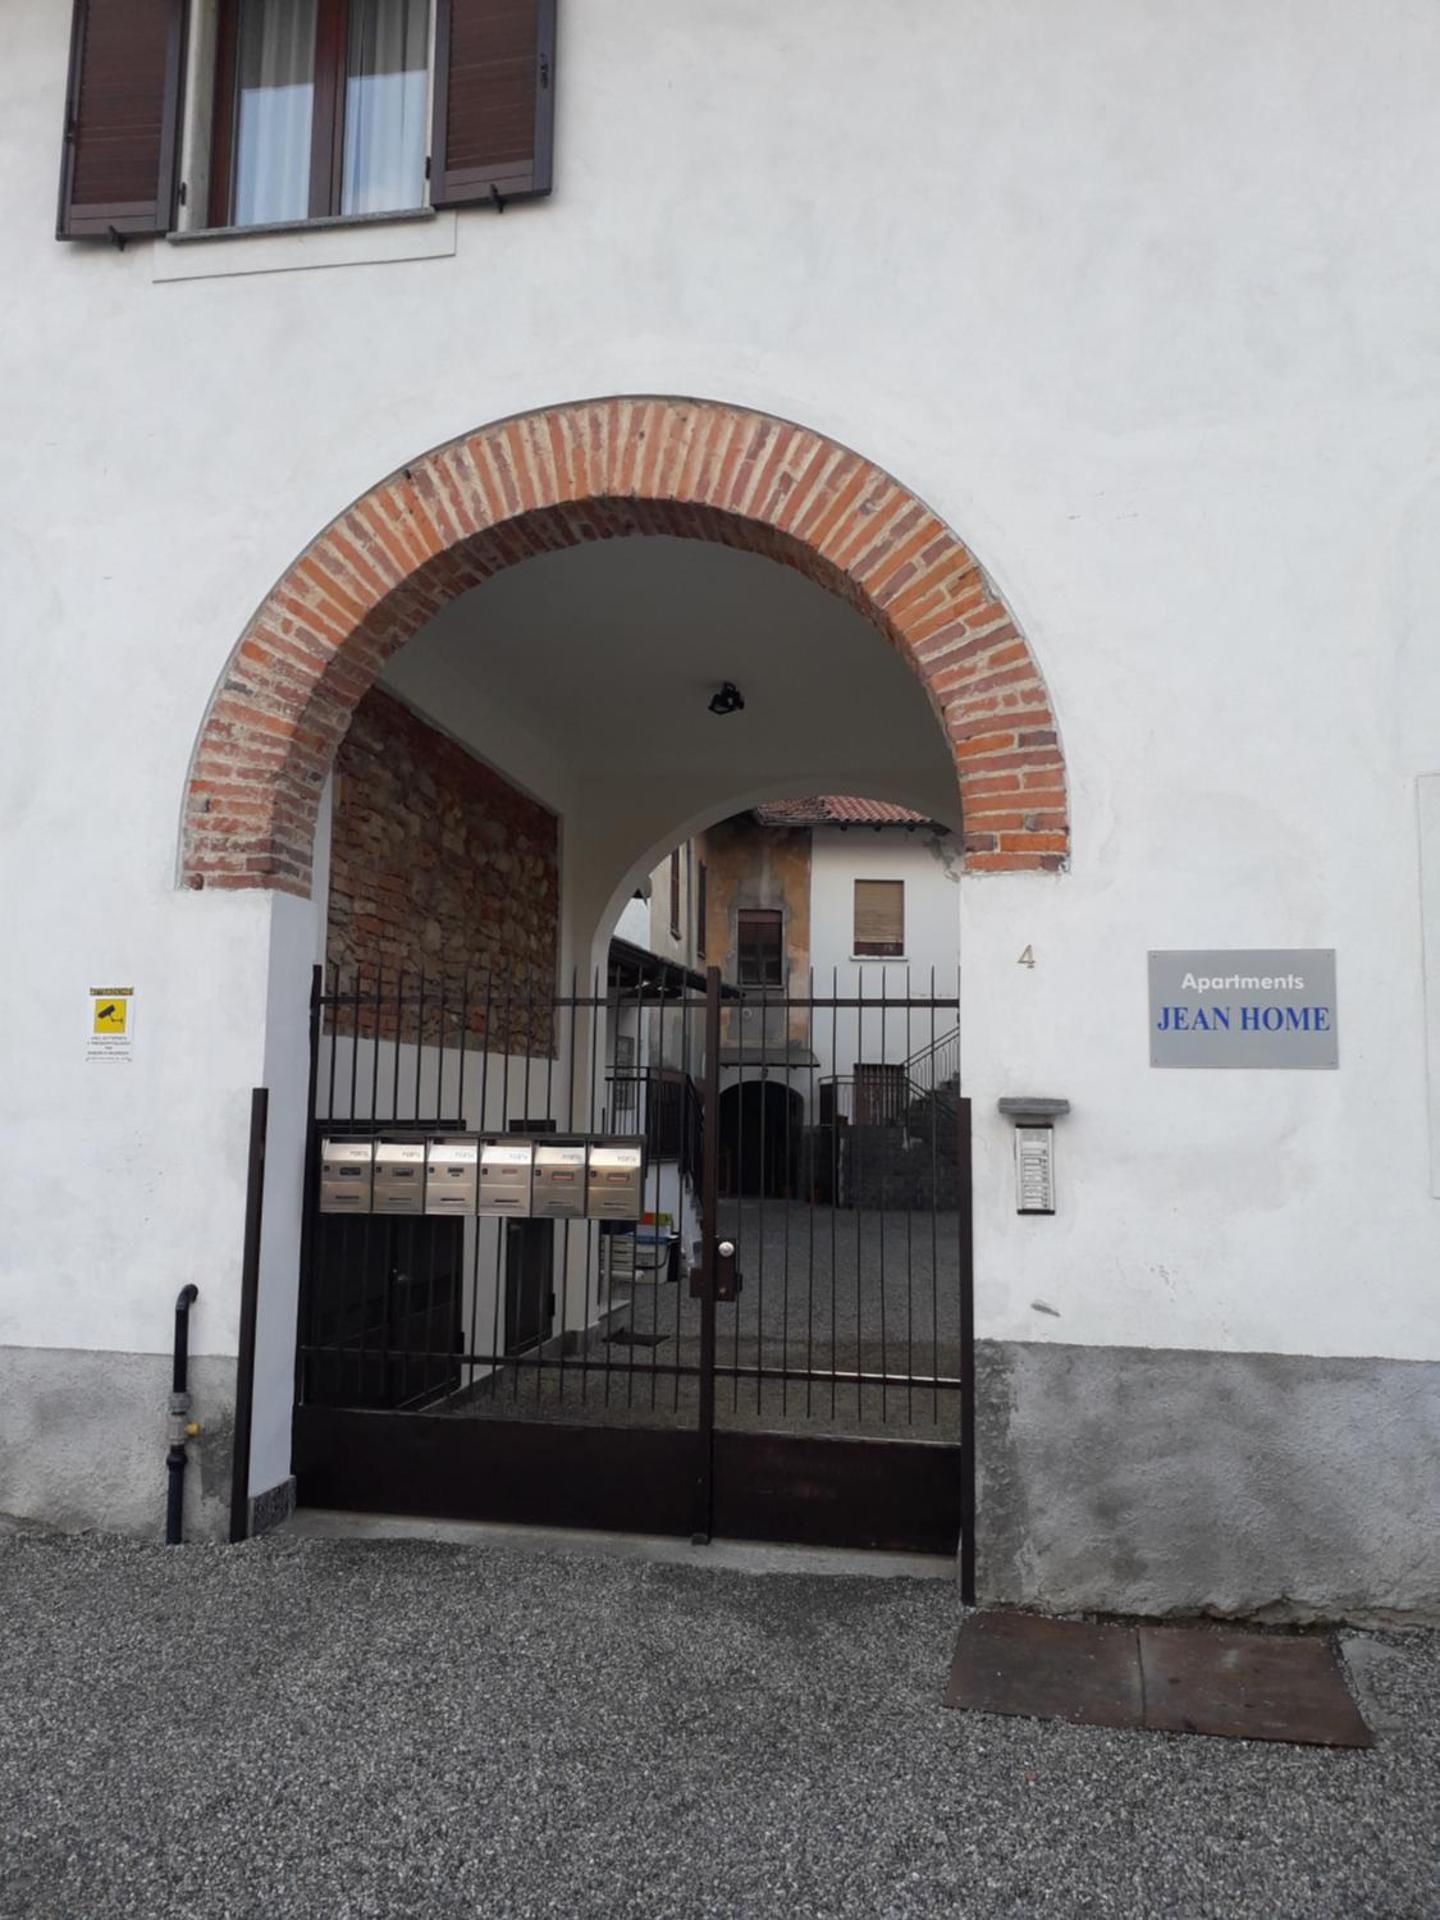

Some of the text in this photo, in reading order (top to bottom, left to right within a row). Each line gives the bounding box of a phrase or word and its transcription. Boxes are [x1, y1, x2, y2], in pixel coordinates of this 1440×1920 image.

[1017, 944, 1035, 969] 4
[1181, 973, 1304, 993] Apartments
[1157, 1006, 1330, 1031] JEAN HOME
